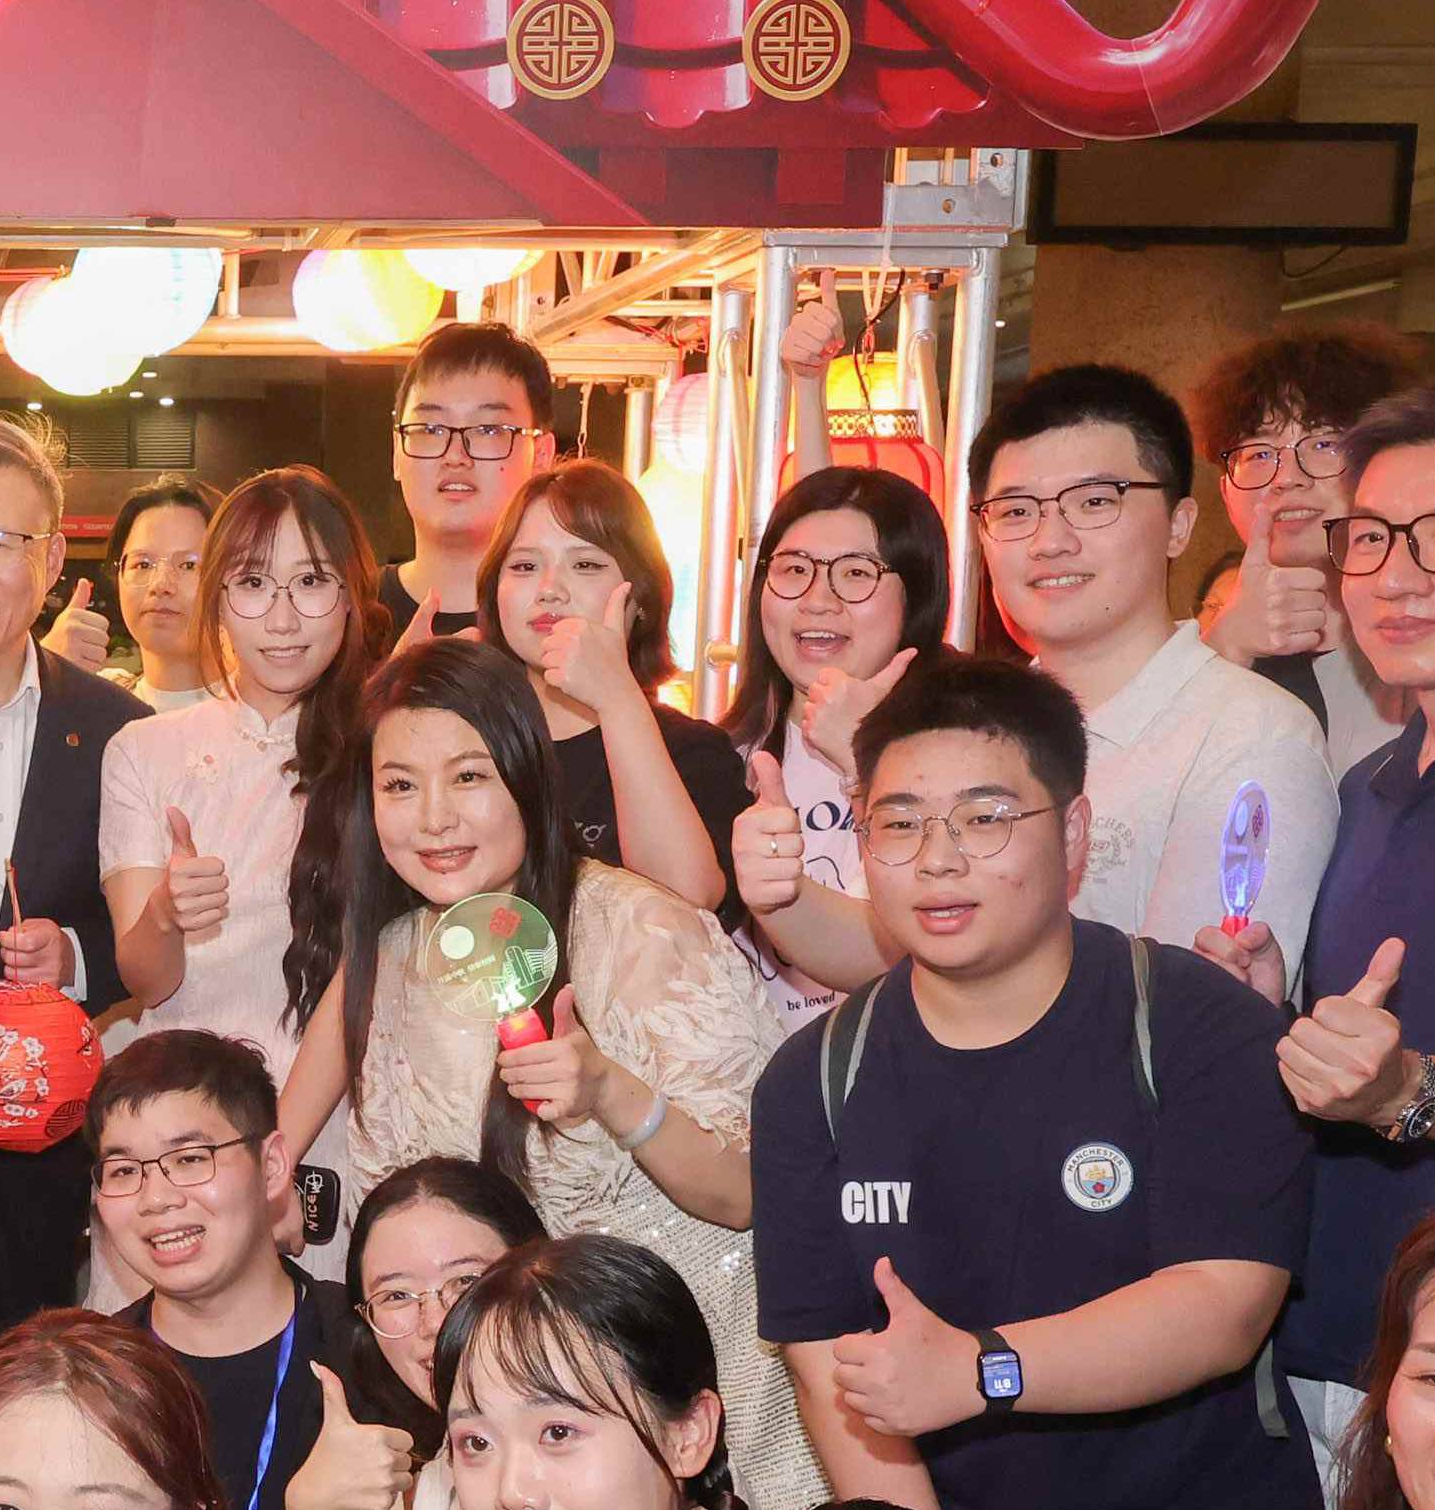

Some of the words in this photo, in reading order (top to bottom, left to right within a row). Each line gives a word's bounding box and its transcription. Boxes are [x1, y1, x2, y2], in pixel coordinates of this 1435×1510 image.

[786, 999, 801, 1012] be
[804, 991, 836, 1008] loved
[1067, 1147, 1125, 1172] MANCHESTER
[841, 1181, 912, 1224] CITY
[1090, 1199, 1113, 1209] CITY
